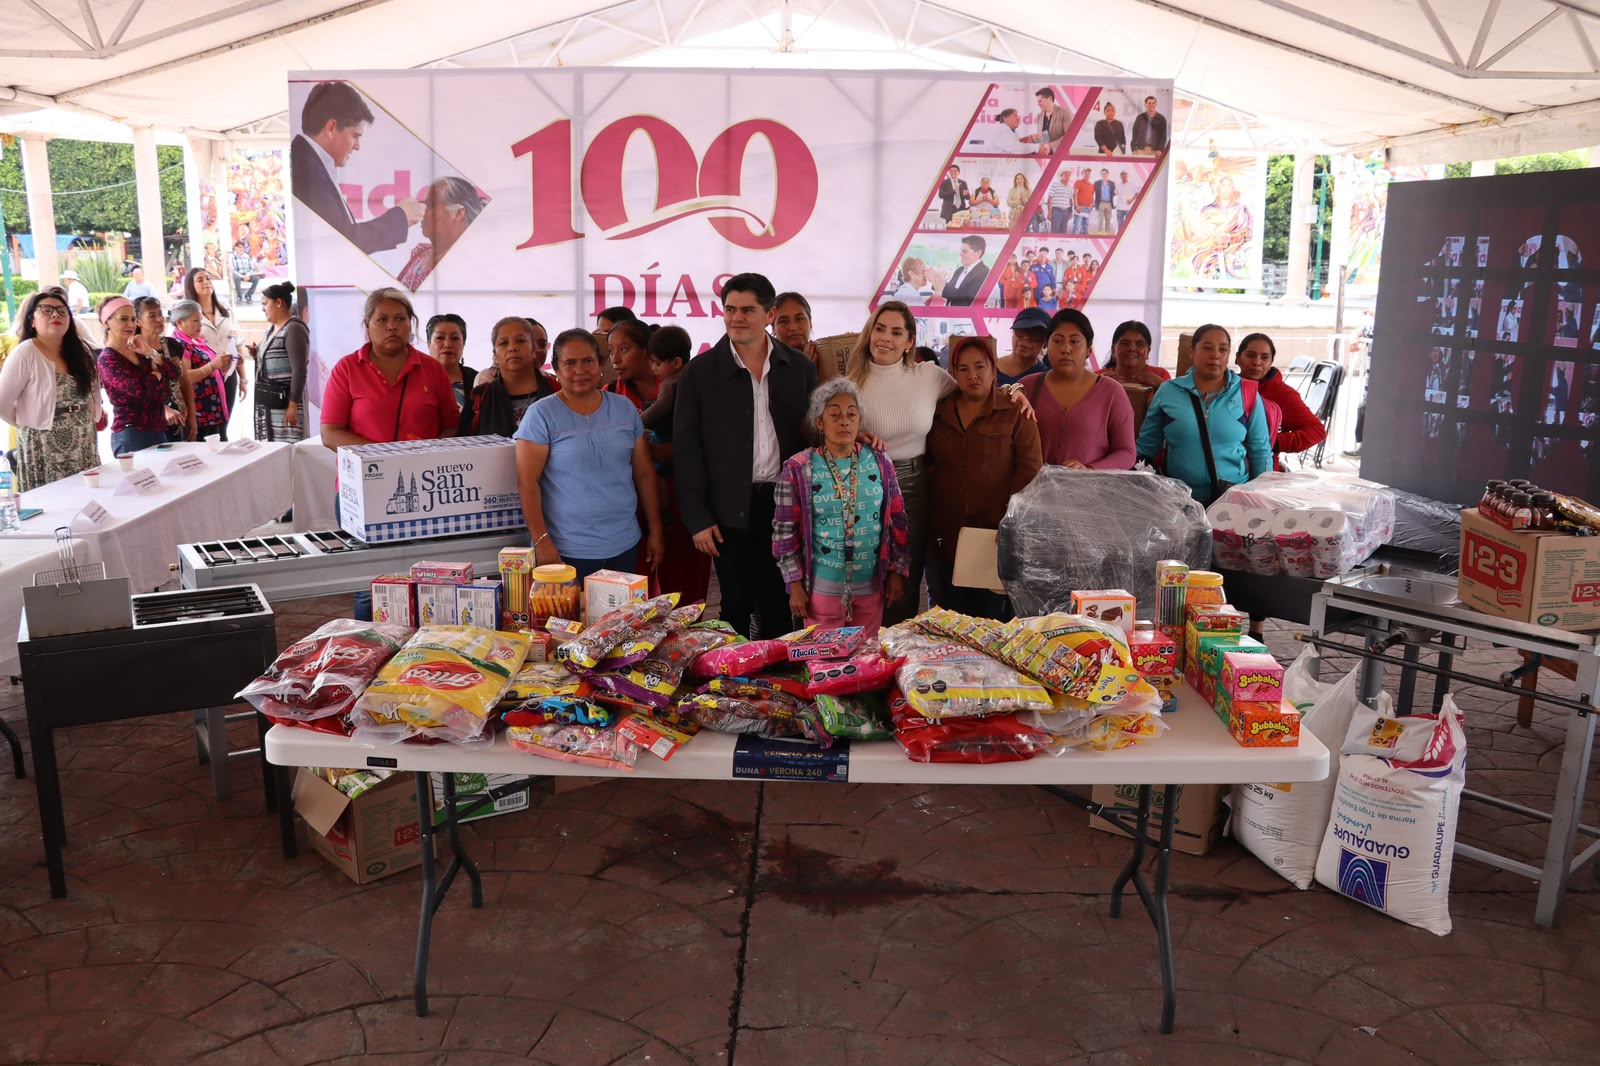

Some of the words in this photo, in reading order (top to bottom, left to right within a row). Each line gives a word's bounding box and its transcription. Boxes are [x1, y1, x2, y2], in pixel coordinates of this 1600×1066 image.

[511, 114, 819, 250] 100
[421, 470, 465, 492] San
[422, 486, 480, 513] Juan
[483, 496, 497, 504] 360
[791, 648, 818, 658] Nucita
[1137, 654, 1168, 666] Bubbaloo
[1239, 674, 1280, 689] Bubbaloo
[1251, 721, 1290, 735] Bubbaloo
[768, 767, 804, 776] VERONA
[806, 768, 822, 776] 240
[1253, 785, 1263, 795] 25
[1264, 789, 1274, 800] kg
[1370, 783, 1405, 795] CONTENIDO
[1358, 806, 1375, 818] Trigo
[1377, 812, 1387, 820] de
[1389, 814, 1416, 824] Harina
[1333, 823, 1410, 859] GUADALUPE
[1431, 821, 1446, 879] GUADALUPE
